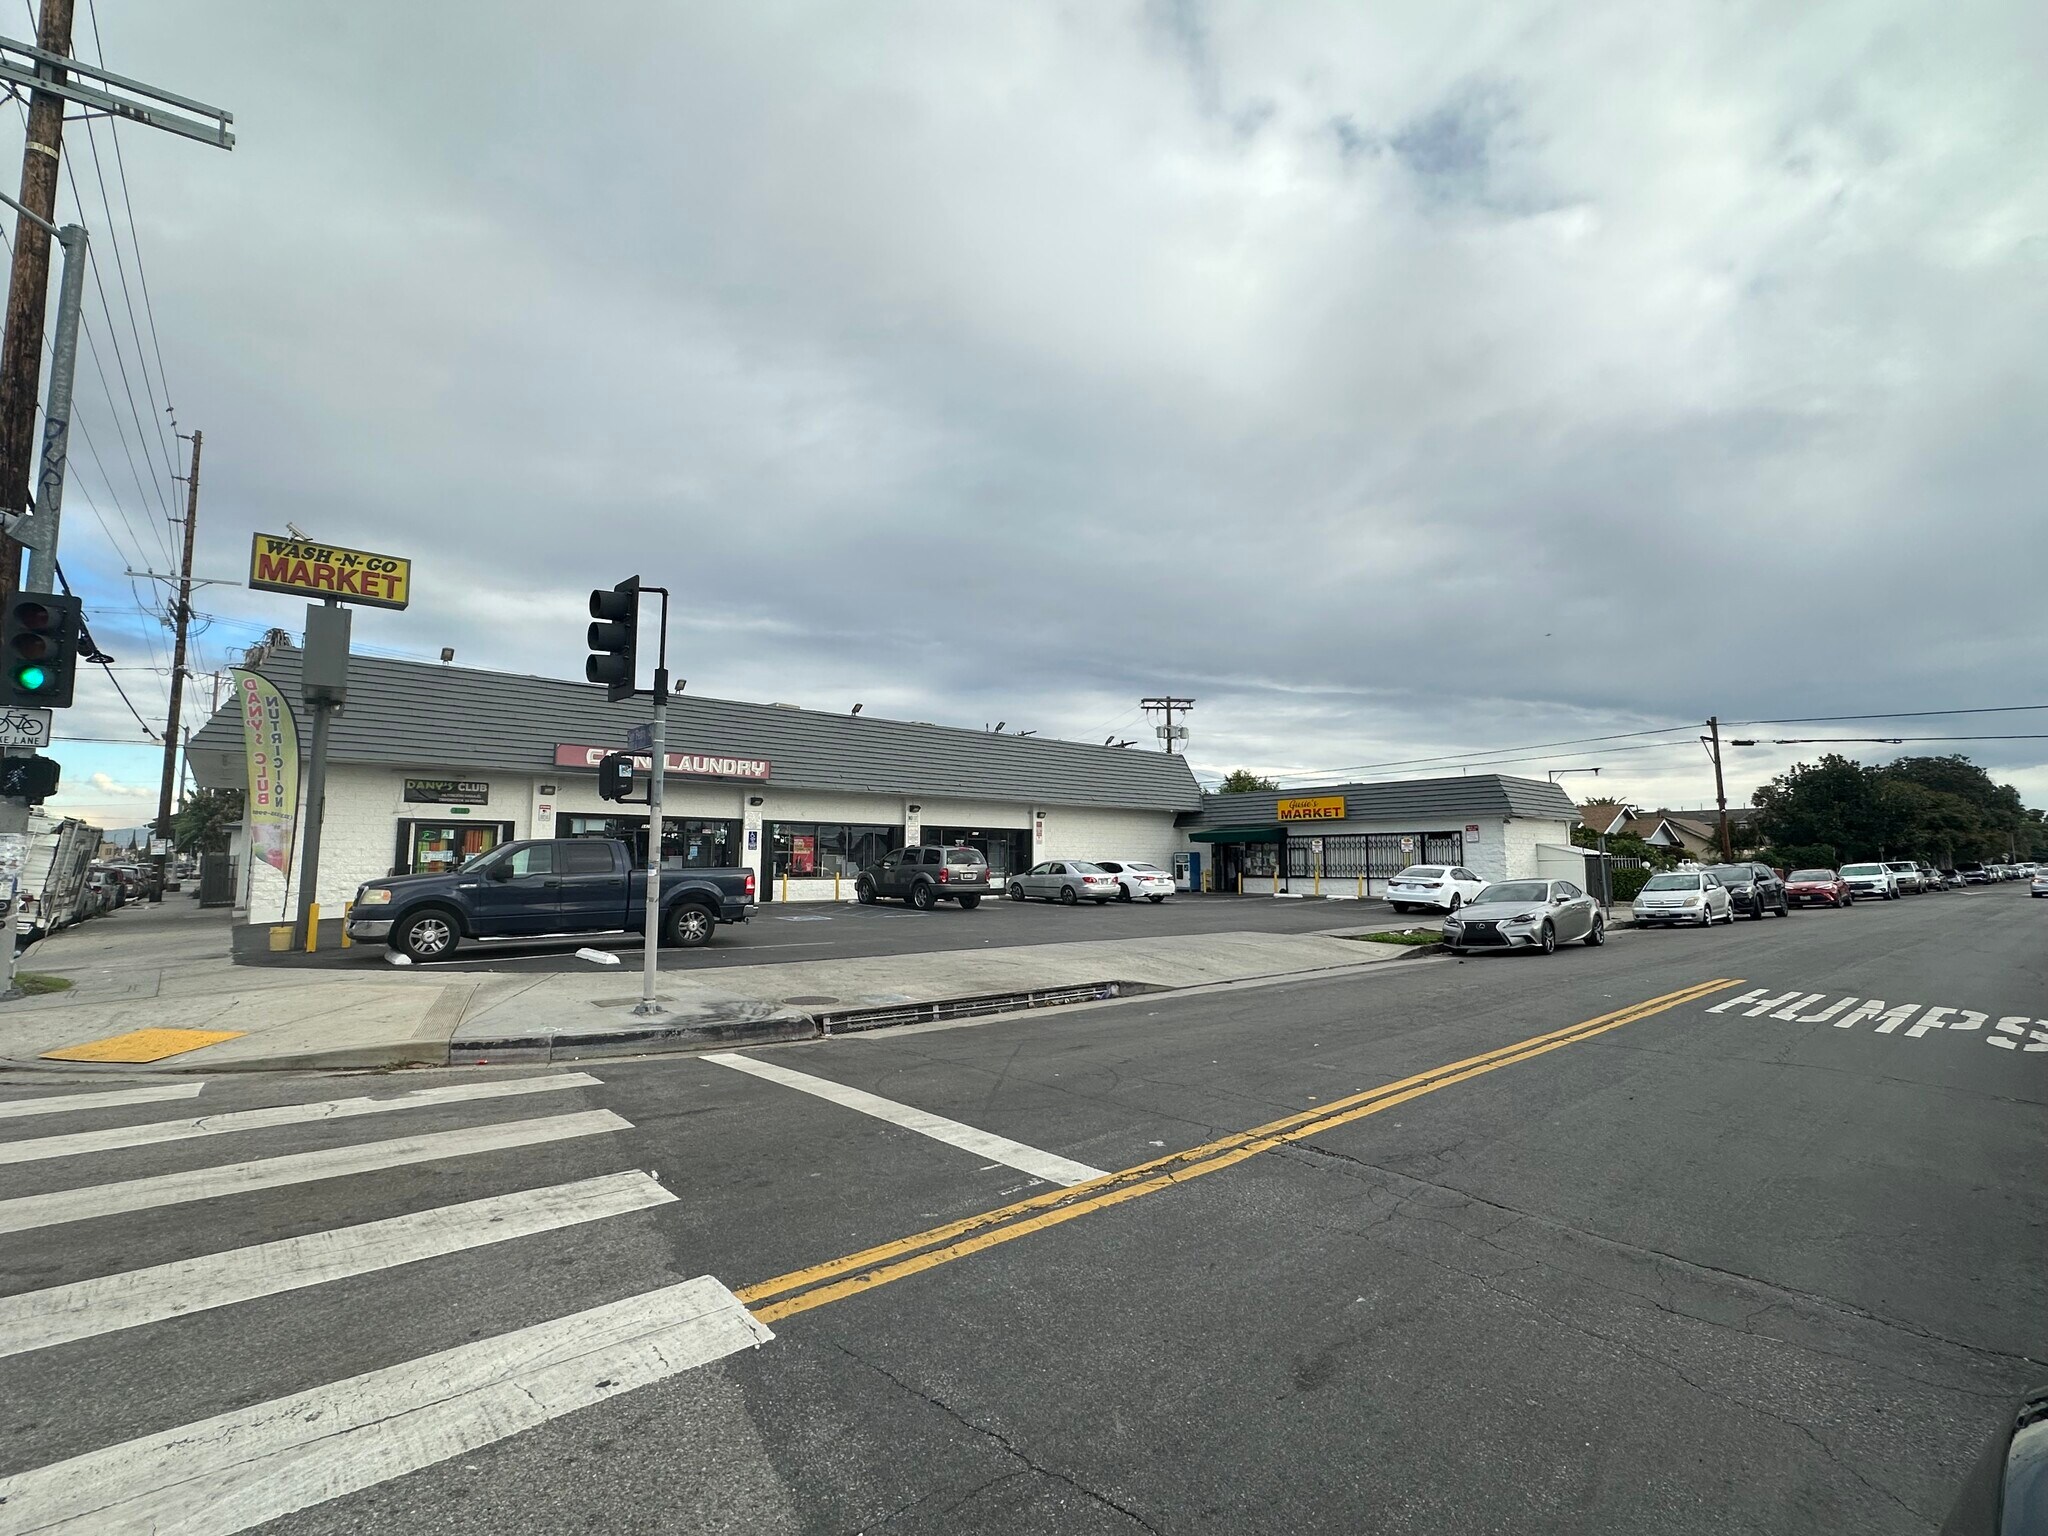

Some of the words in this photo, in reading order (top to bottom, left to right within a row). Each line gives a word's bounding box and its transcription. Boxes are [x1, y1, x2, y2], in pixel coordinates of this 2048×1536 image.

[258, 554, 402, 599] MARKET
[14, 736, 40, 745] LANE
[663, 754, 765, 776] LAUNDRY
[406, 780, 454, 791] DANY'S
[457, 782, 488, 792] CLUB
[1280, 806, 1341, 819] MARKET
[1704, 988, 2048, 1052] HUMPS
